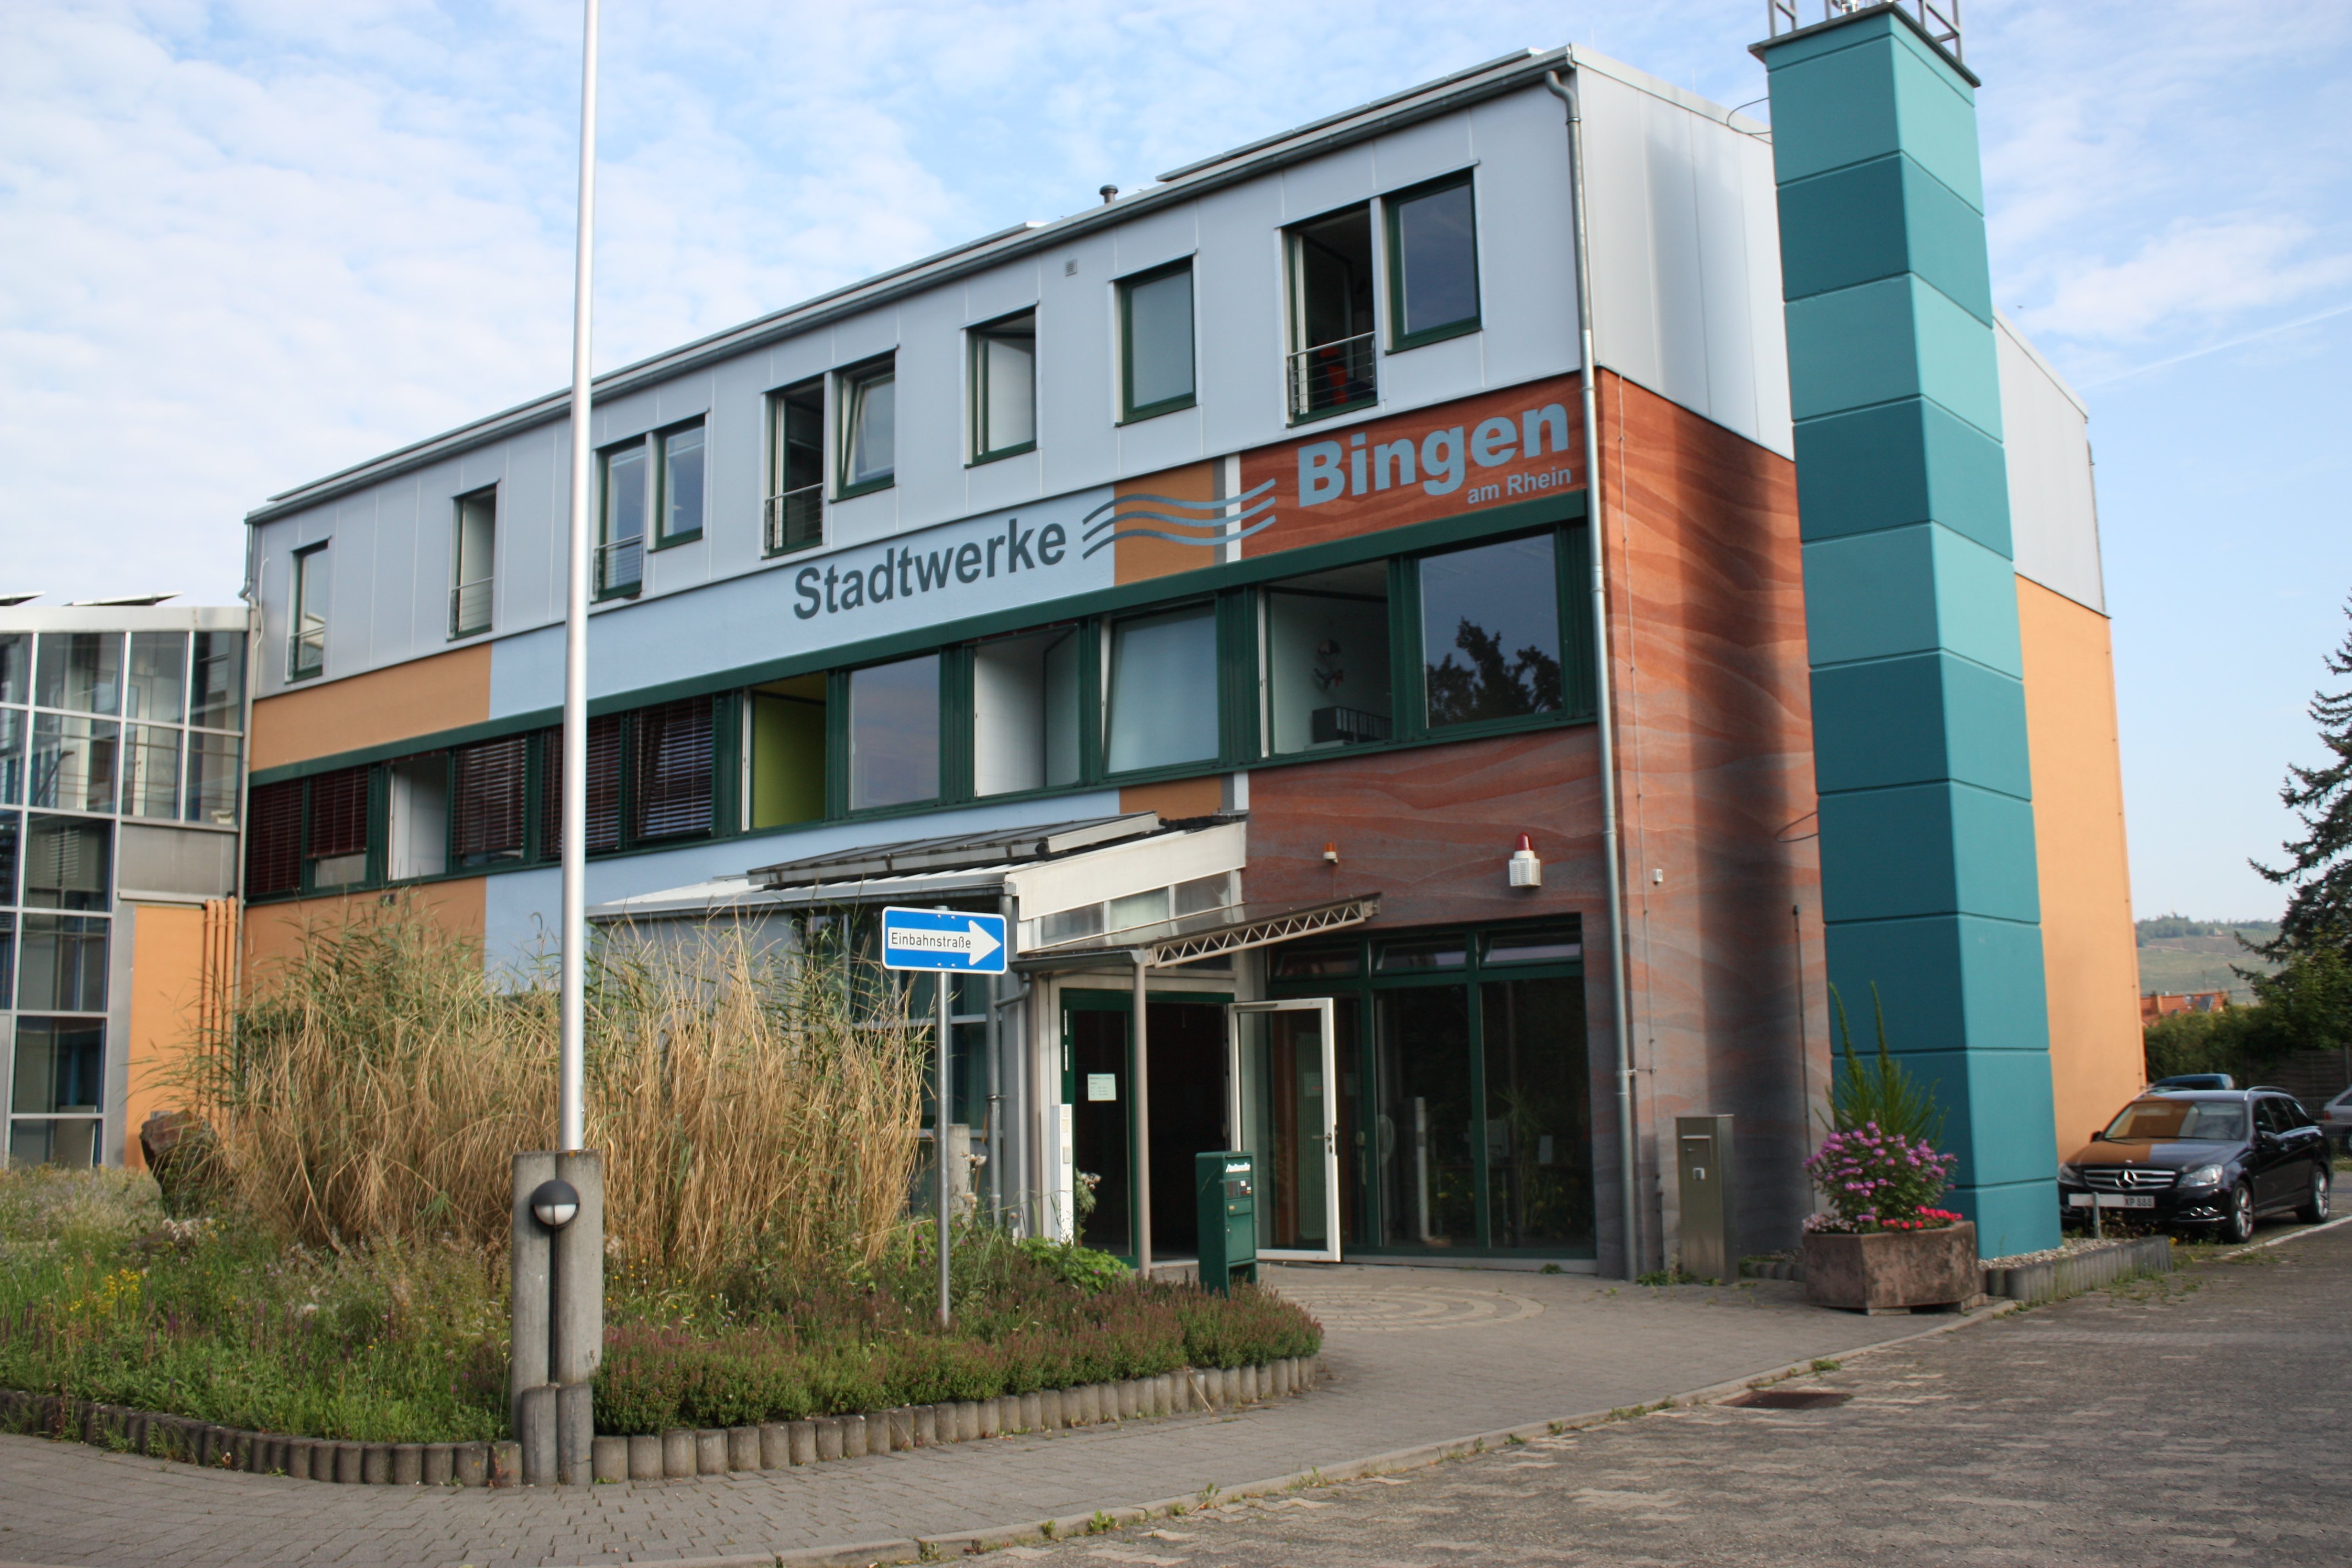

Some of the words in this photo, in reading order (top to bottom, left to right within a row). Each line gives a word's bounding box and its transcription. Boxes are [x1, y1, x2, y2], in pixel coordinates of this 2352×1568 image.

[1298, 403, 1569, 507] Bingen
[1468, 484, 1500, 504] am
[1507, 467, 1571, 497] Rhein
[793, 518, 1066, 619] Stadtwerke
[891, 932, 971, 948] Einbahnstraße
